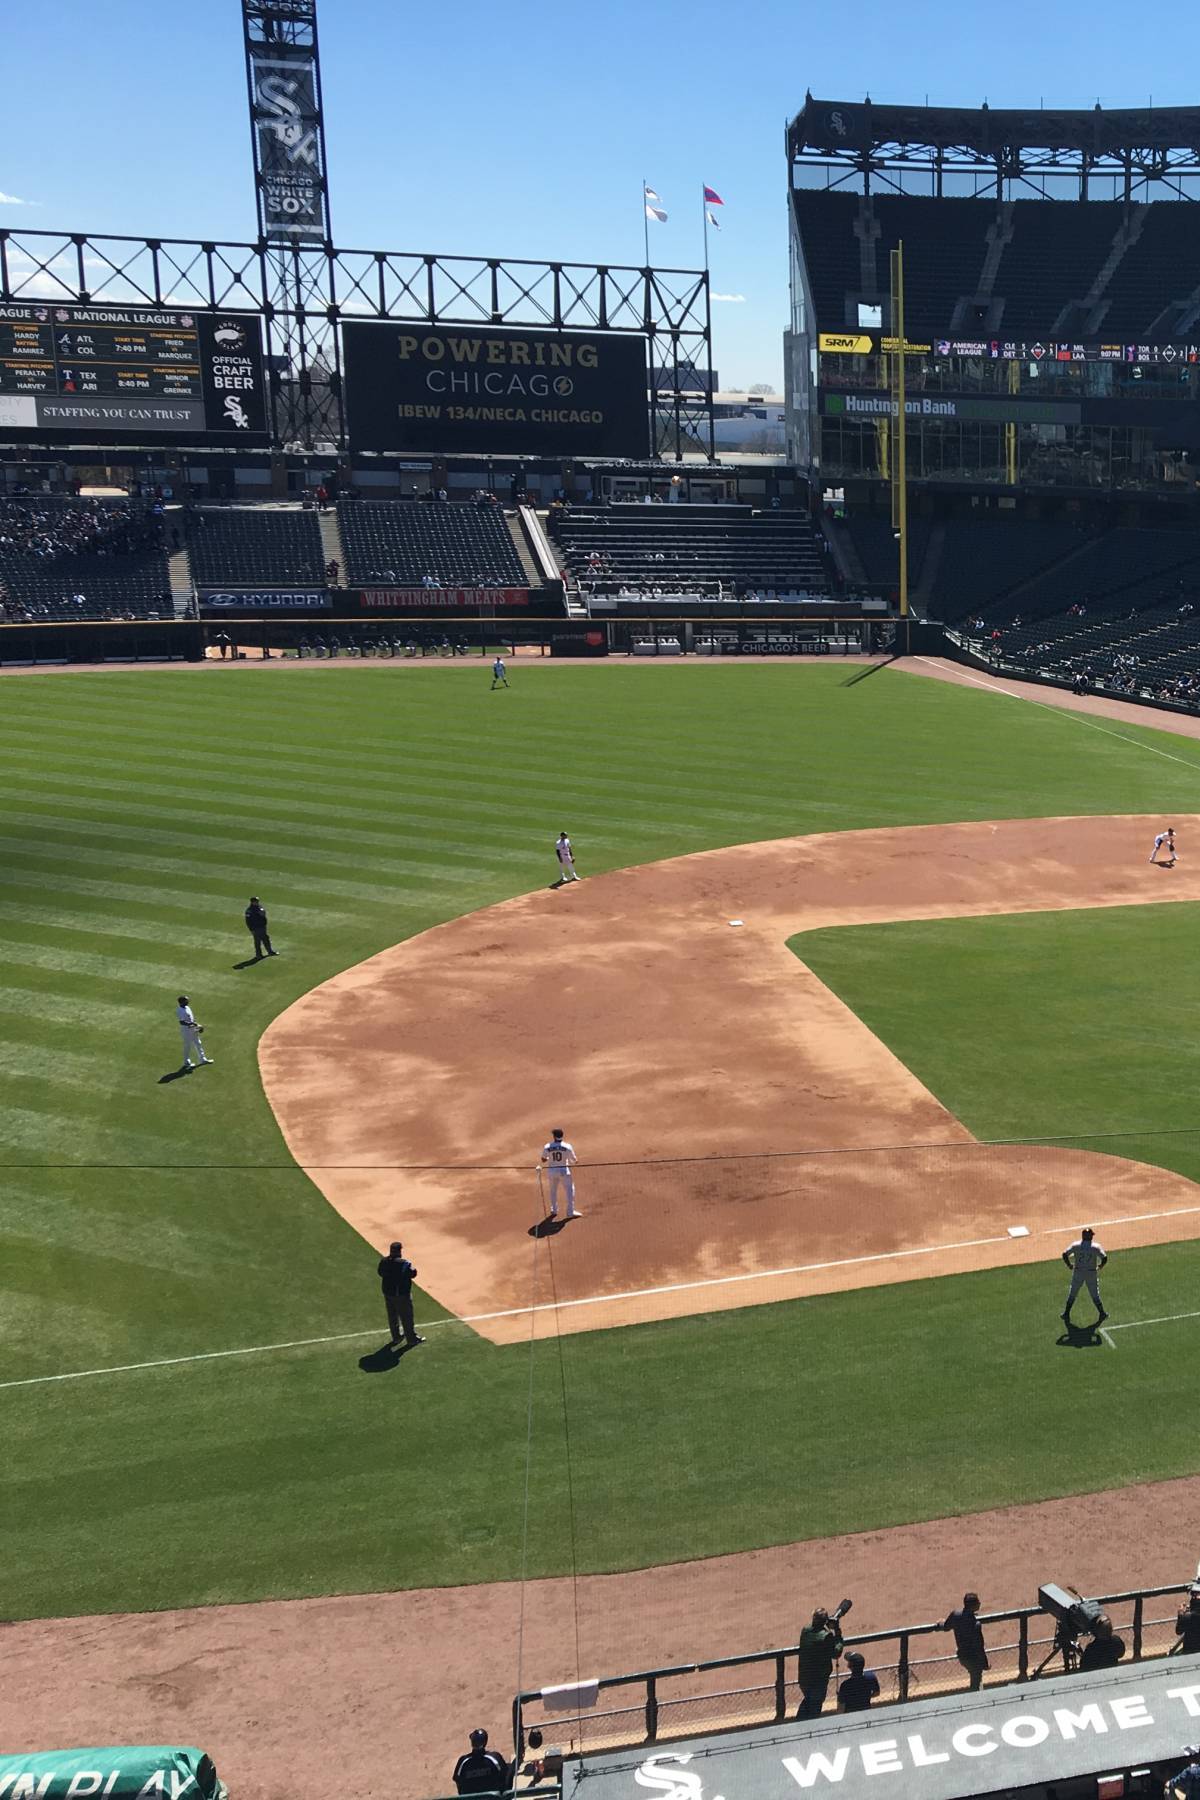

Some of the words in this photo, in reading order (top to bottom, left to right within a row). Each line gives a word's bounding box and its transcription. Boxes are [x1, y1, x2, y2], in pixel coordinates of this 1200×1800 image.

[265, 175, 314, 187] CHICAGO
[266, 185, 315, 198] WHITE
[267, 196, 316, 215] SOX
[73, 311, 132, 323] NATIONAL
[133, 314, 178, 325] LEAGUE
[14, 332, 40, 340] HARDY
[76, 335, 95, 344] ATL
[825, 338, 854, 347] SRM
[952, 342, 987, 350] AMERICAN
[77, 346, 96, 355] COL
[133, 345, 147, 353] PM
[398, 335, 598, 368] POWERING
[1003, 350, 1016, 358] DET
[1138, 345, 1150, 353] TOR
[158, 351, 193, 360] MARQUEZ
[211, 355, 253, 365] OFFICIAL
[15, 369, 47, 377] PERALTA
[79, 371, 97, 380] TEX
[213, 365, 253, 376] CRAFT
[17, 382, 46, 390] HARVEY
[82, 382, 98, 391] ARI
[136, 380, 150, 388] PM
[214, 376, 254, 390] BEER
[426, 369, 574, 397] CHICAGO
[845, 395, 921, 417] Huntingon
[922, 398, 956, 416] Bank
[43, 406, 101, 418] STAFFING
[101, 408, 127, 418] YOU
[128, 409, 152, 419] CAN
[153, 409, 191, 420] TRUST
[398, 404, 441, 419] IBEW
[446, 406, 527, 422] 134/NECA
[531, 408, 604, 424] CHICAGO
[242, 594, 324, 605] HYUNDAI
[364, 590, 458, 606] WHITTINGHAM
[463, 589, 506, 605] MEATS
[742, 643, 799, 653] CHICAGO'S
[801, 643, 827, 652] BEER
[551, 1151, 563, 1162] 10
[781, 1694, 1155, 1788] WELCOME
